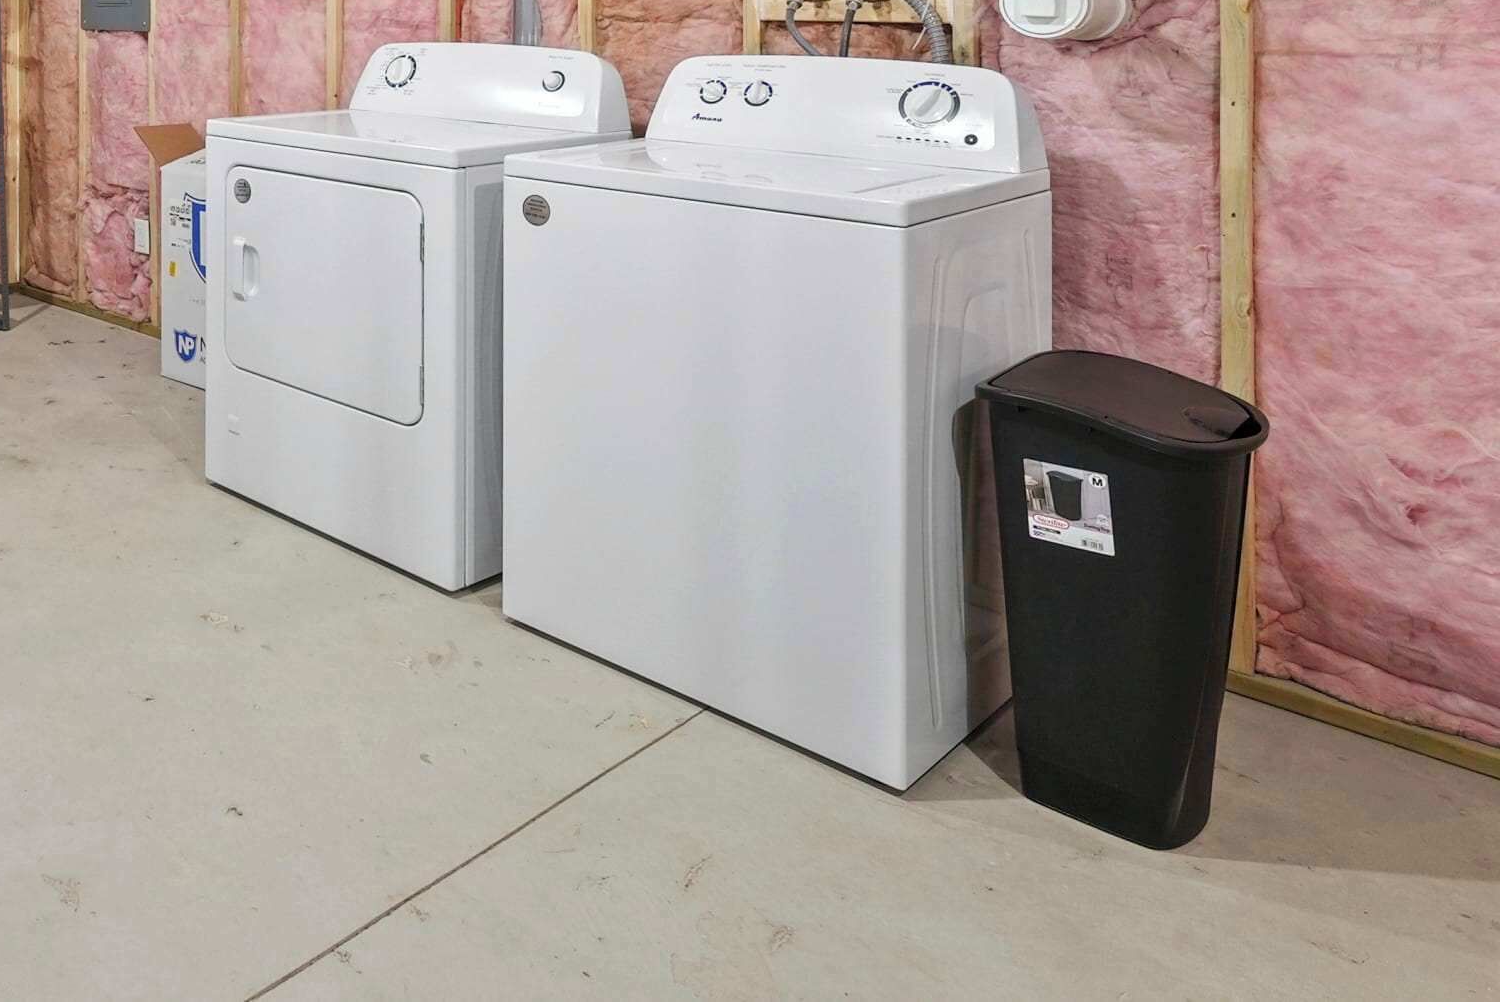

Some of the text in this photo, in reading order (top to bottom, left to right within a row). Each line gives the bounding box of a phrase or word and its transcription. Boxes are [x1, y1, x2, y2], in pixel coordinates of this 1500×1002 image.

[691, 112, 723, 123] Amana
[178, 334, 195, 356] NP
[1093, 478, 1103, 486] M
